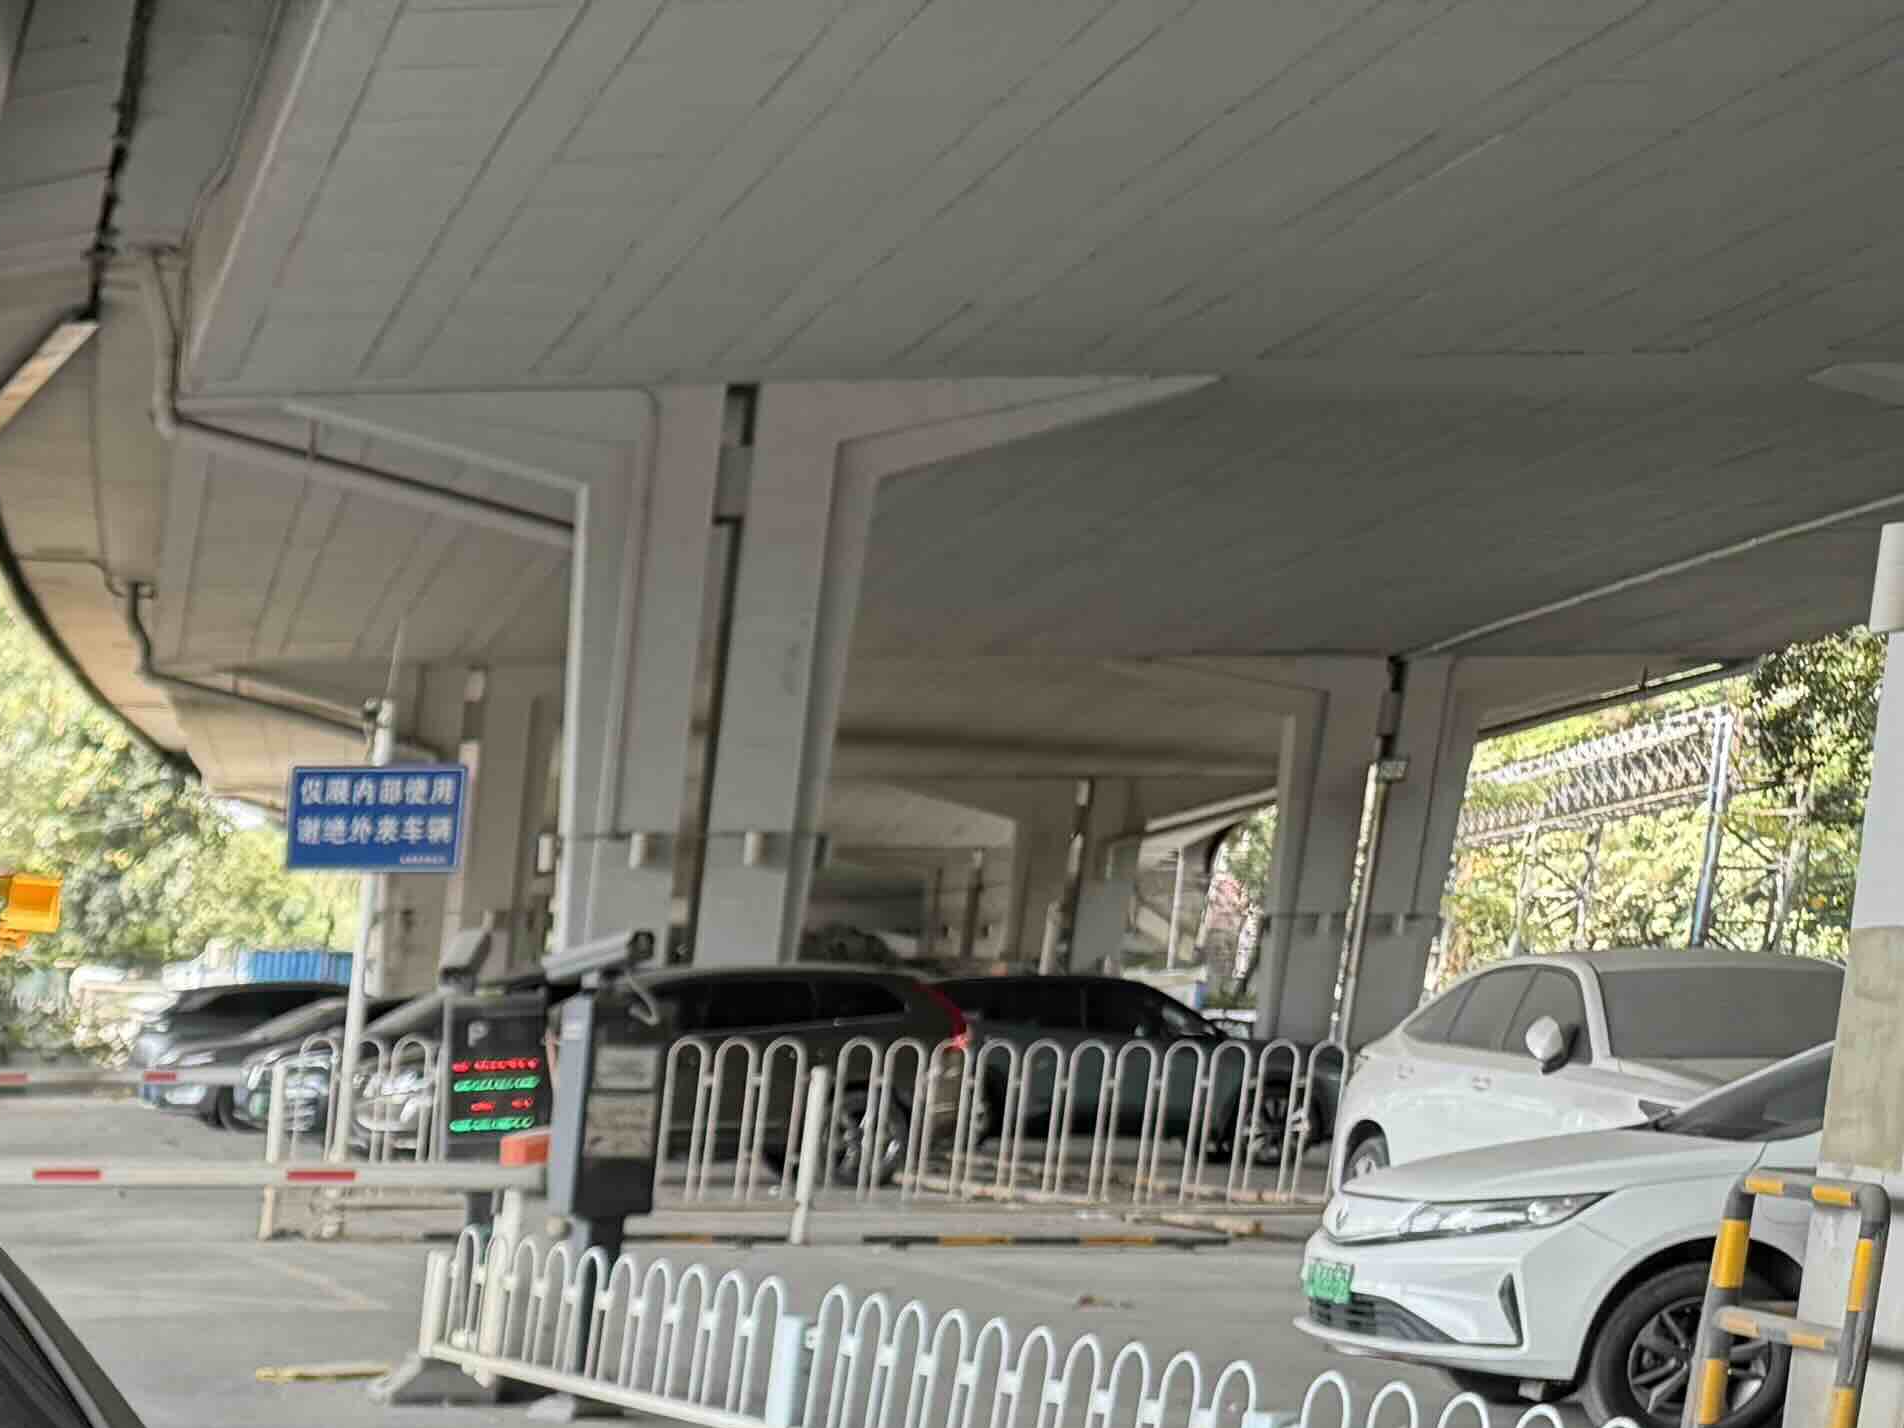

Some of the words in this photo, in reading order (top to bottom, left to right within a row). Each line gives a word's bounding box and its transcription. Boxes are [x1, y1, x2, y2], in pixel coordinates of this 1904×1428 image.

[301, 776, 455, 806] 仅限内部使用
[297, 815, 453, 846] 谢绝外来车辆
